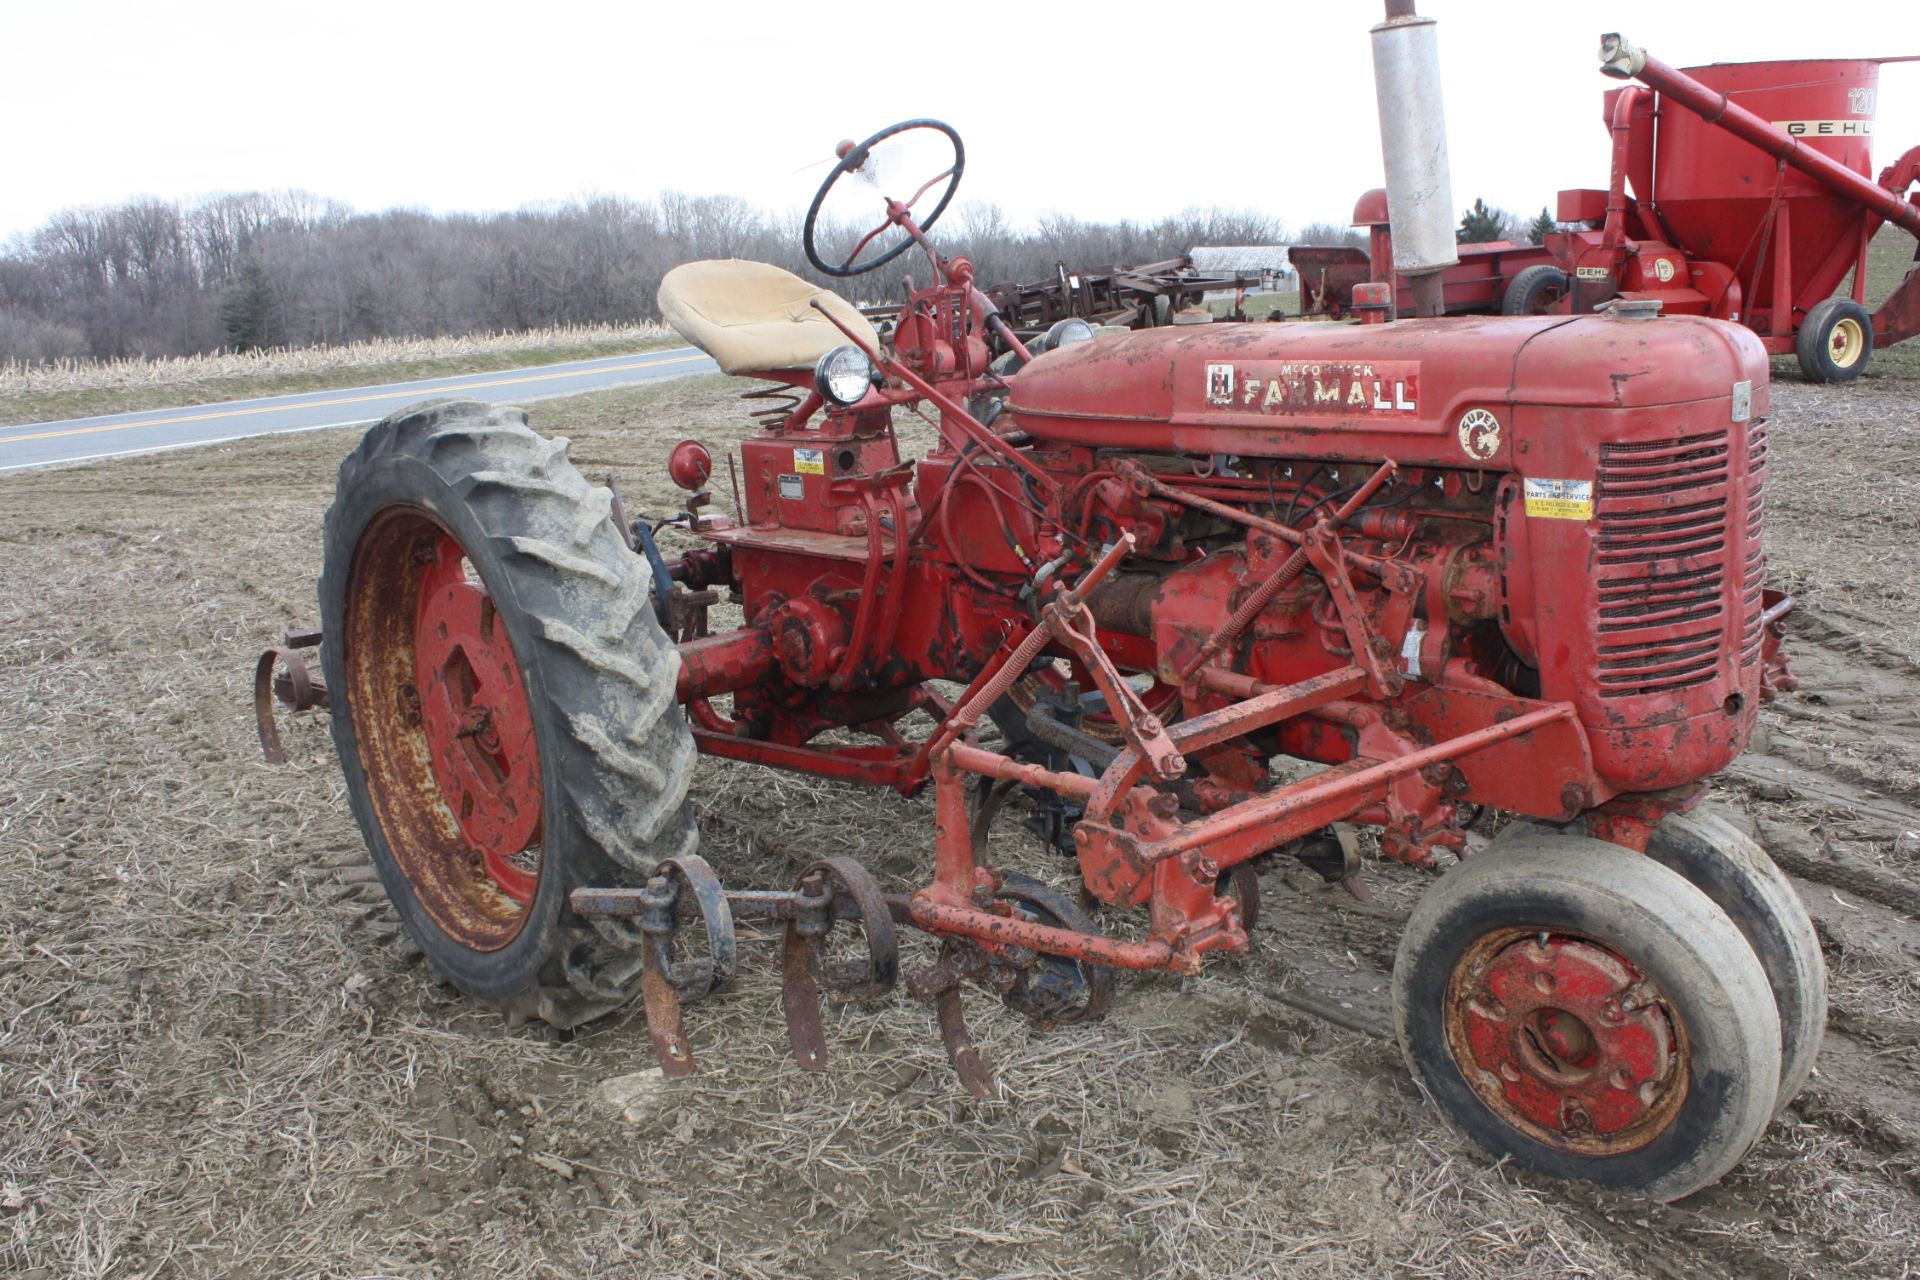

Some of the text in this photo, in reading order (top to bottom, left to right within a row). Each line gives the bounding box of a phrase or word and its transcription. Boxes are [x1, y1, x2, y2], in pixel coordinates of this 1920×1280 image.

[1787, 123, 1870, 134] GEHL
[1578, 268, 1607, 276] GEHL
[1281, 364, 1373, 377] McCOCK
[1462, 411, 1497, 430] SUPER
[1526, 491, 1546, 499] PARTS
[1562, 493, 1590, 501] SERVICE
